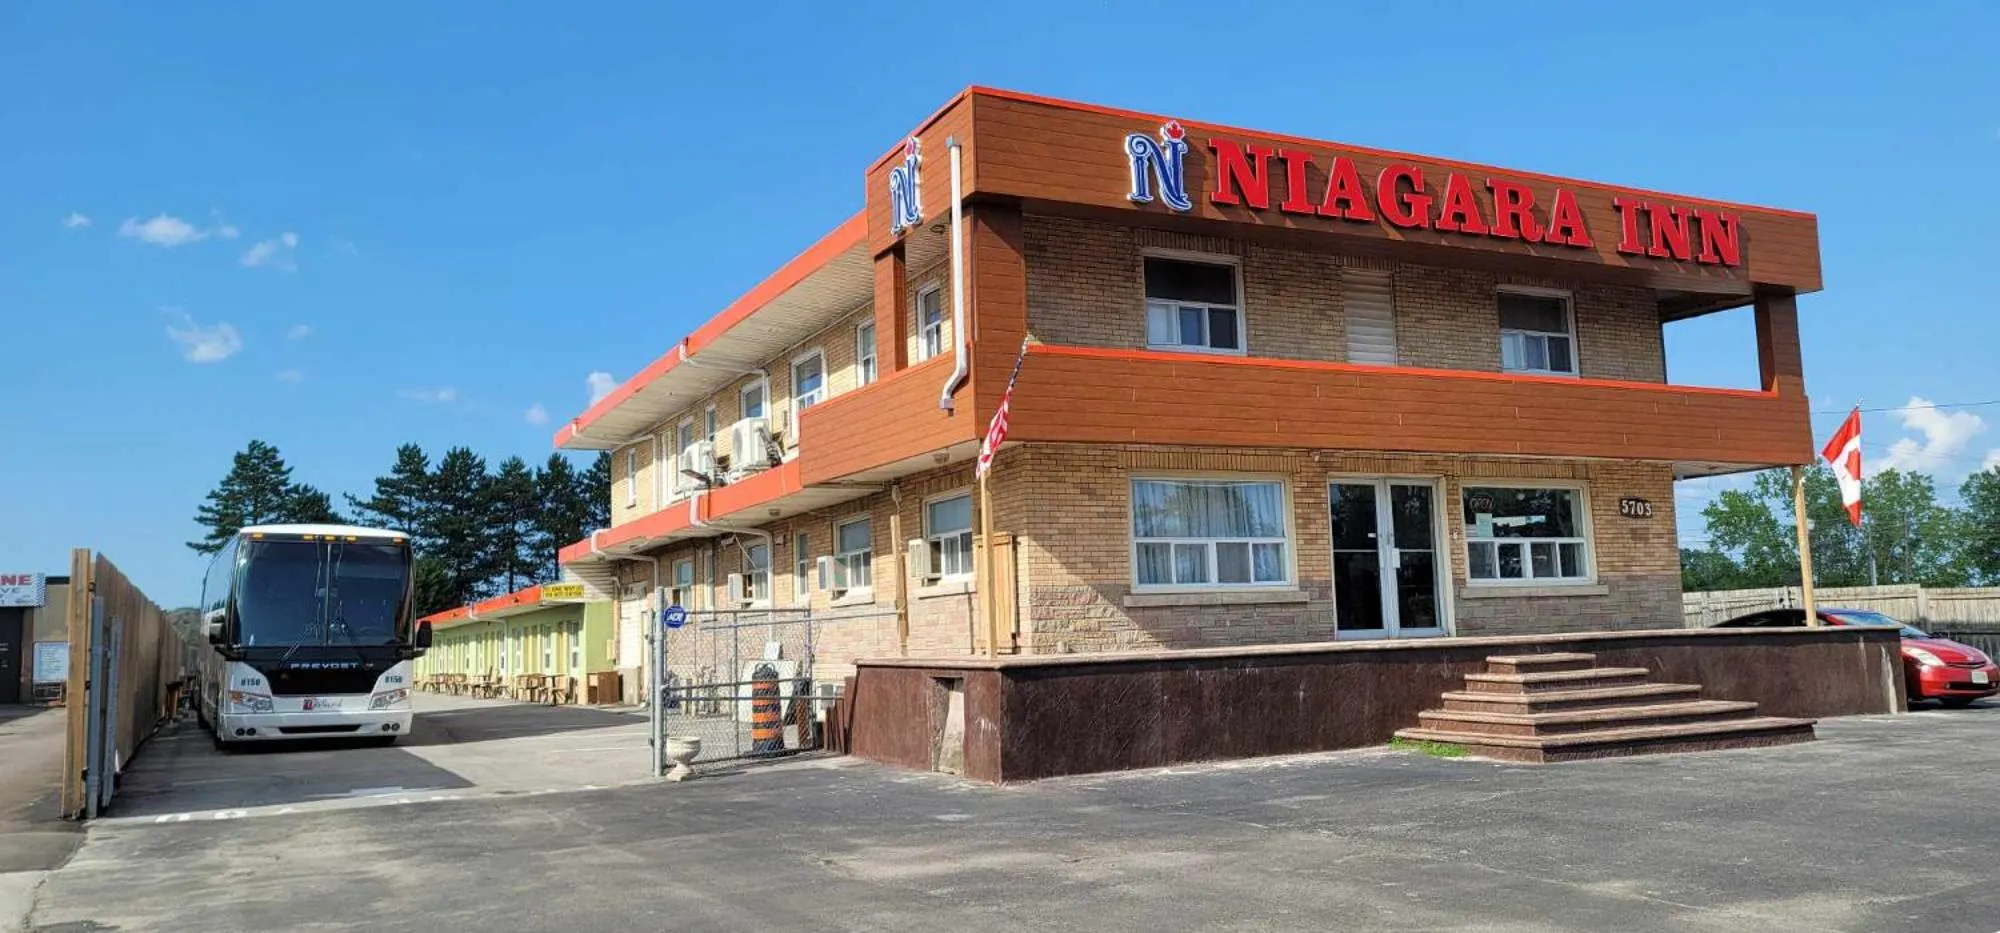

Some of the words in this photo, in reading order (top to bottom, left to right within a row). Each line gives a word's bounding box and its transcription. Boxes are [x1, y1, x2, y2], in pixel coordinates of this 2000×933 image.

[1209, 137, 1593, 249] NIAGARA
[1615, 198, 1740, 267] INN
[1622, 500, 1652, 516] 5703
[290, 662, 358, 670] PREVOST
